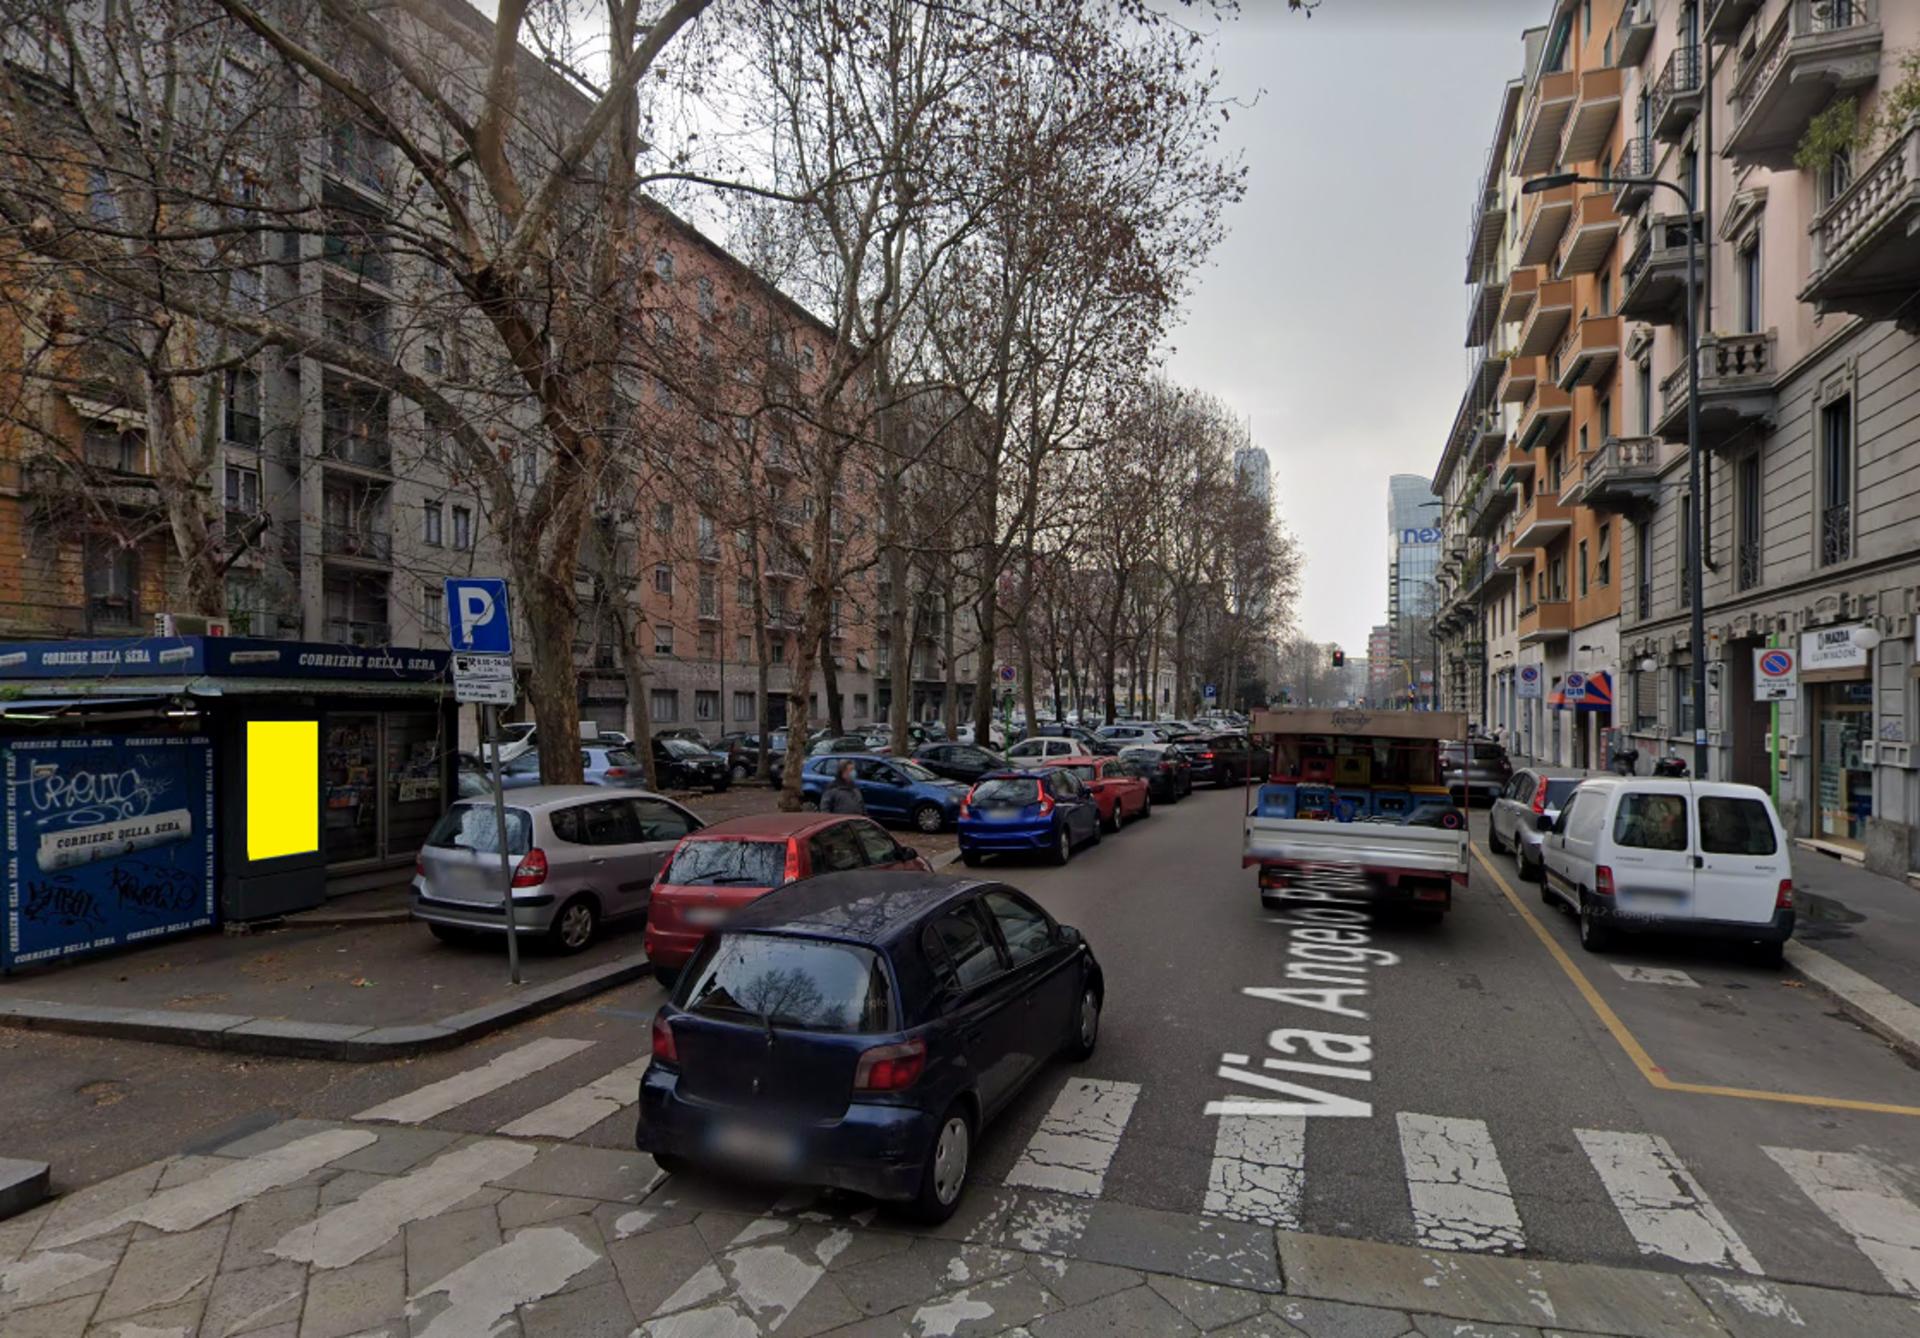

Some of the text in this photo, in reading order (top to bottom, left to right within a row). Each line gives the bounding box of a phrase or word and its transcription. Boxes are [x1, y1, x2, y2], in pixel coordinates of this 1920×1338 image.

[458, 587, 495, 643] P
[42, 652, 88, 666] CORRIERE
[91, 650, 120, 664] DELLA
[124, 649, 150, 664] SERA
[299, 654, 436, 671] CORRIERE DELLA SERA
[1205, 686, 1214, 697] P
[57, 821, 181, 849] CORRIERE DELLA SERA
